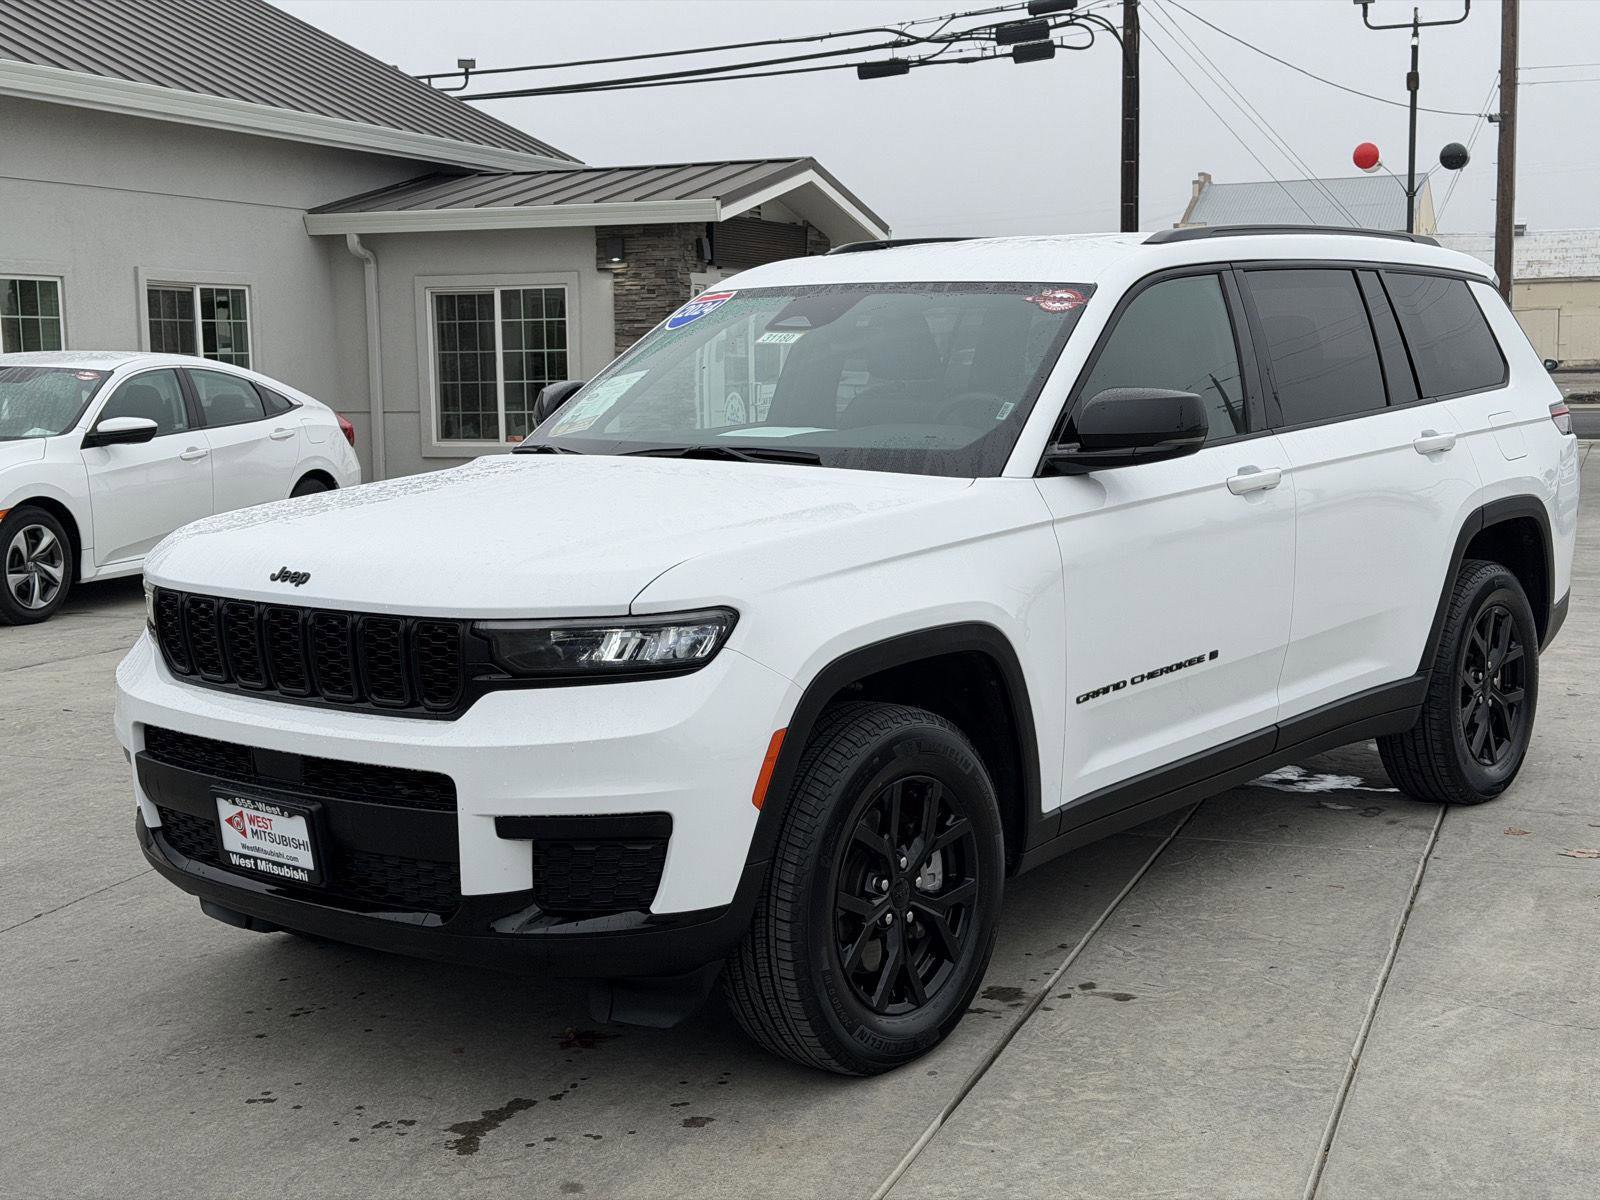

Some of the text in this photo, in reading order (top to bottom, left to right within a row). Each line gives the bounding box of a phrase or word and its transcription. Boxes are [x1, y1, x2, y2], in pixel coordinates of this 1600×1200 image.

[270, 566, 311, 588] Jeep
[1075, 654, 1206, 704] GRAND CHEROKEE
[235, 797, 281, 815] 655-West
[246, 813, 273, 830] WEST
[250, 828, 310, 852] MITSUBISHI
[241, 843, 300, 862] WestMitsubishi.com
[229, 853, 309, 882] West Mitsubishi
